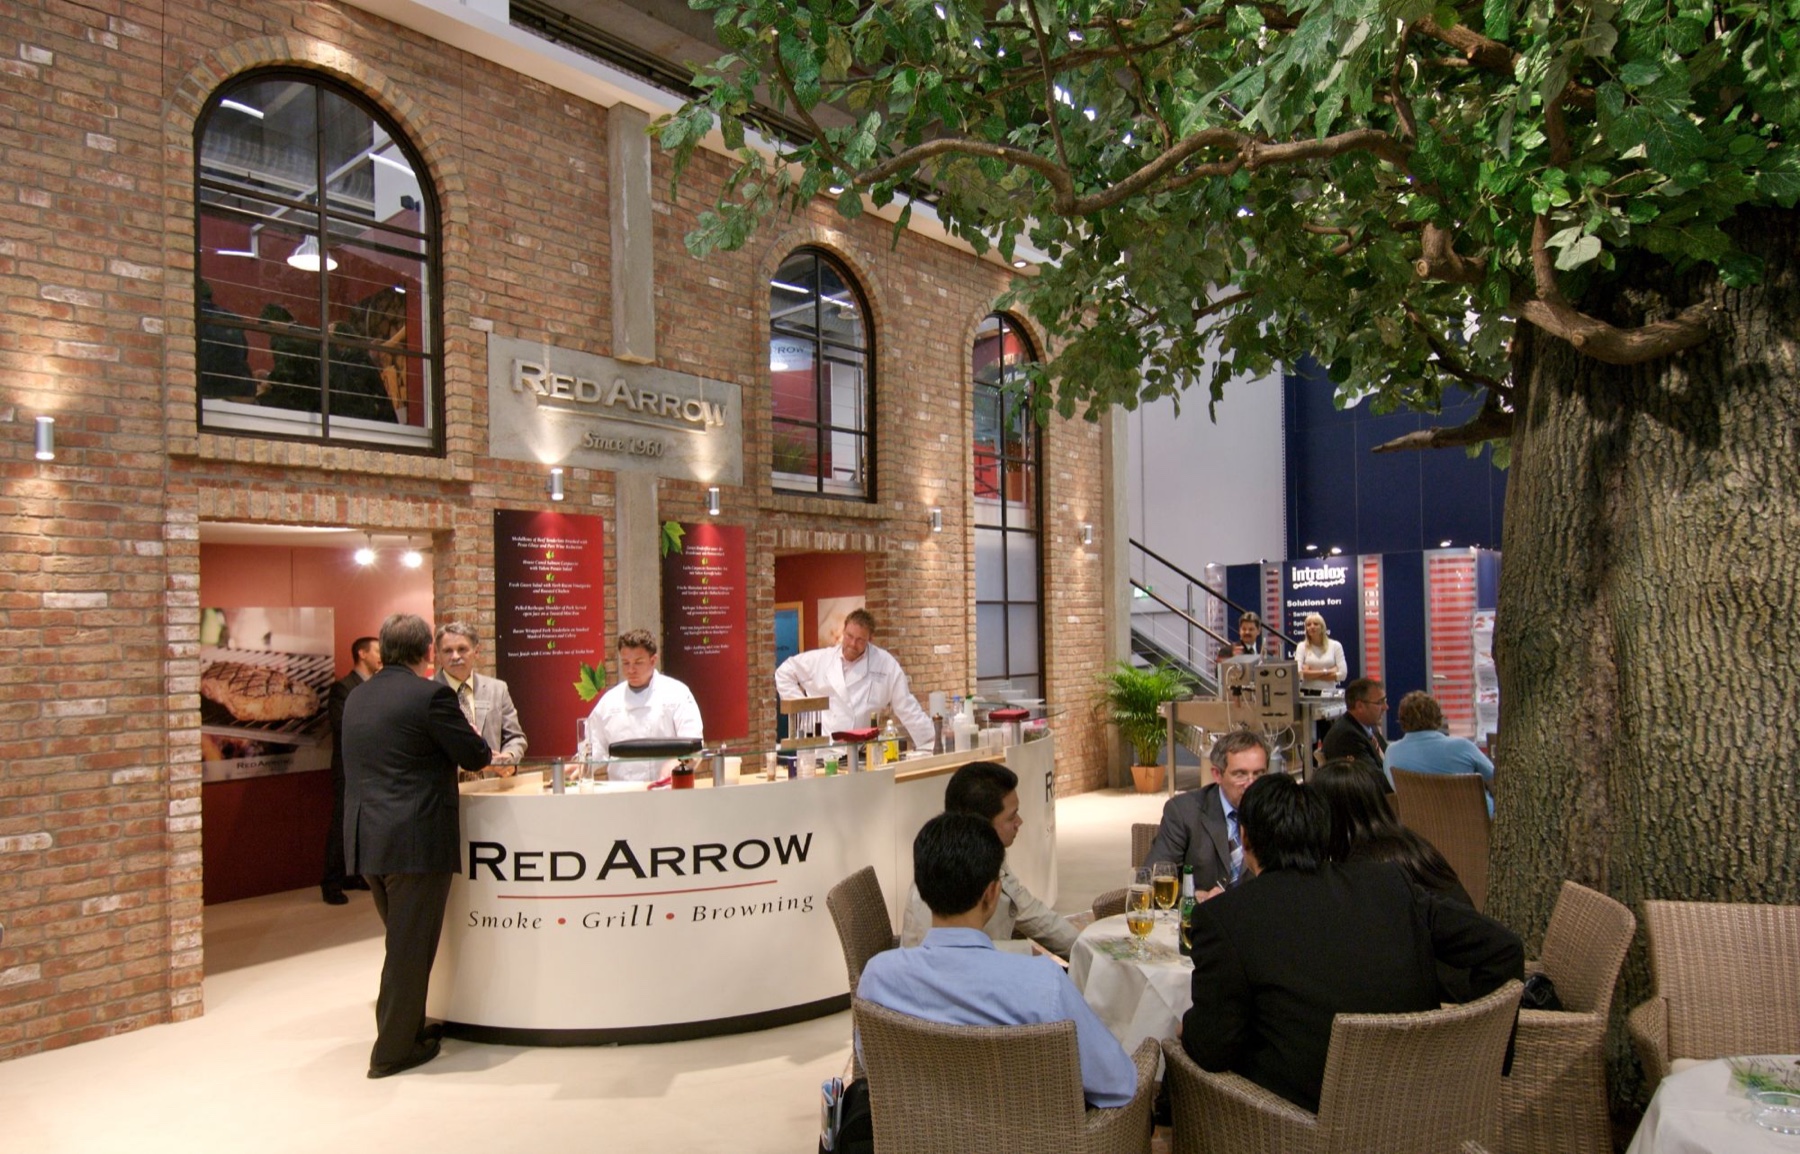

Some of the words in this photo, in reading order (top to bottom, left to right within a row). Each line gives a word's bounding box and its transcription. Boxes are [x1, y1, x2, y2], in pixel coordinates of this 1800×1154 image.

[512, 358, 601, 403] RED
[604, 378, 728, 427] ARROW
[583, 431, 625, 452] Since
[627, 437, 664, 458] 1960
[1292, 565, 1346, 582] intralox
[1286, 599, 1325, 608] Solutions
[1327, 598, 1342, 606] for:
[468, 840, 587, 882] RED
[595, 832, 814, 882] ARROW
[468, 910, 542, 930] Smoke
[582, 904, 654, 930] Grill
[692, 894, 814, 923] Browning
